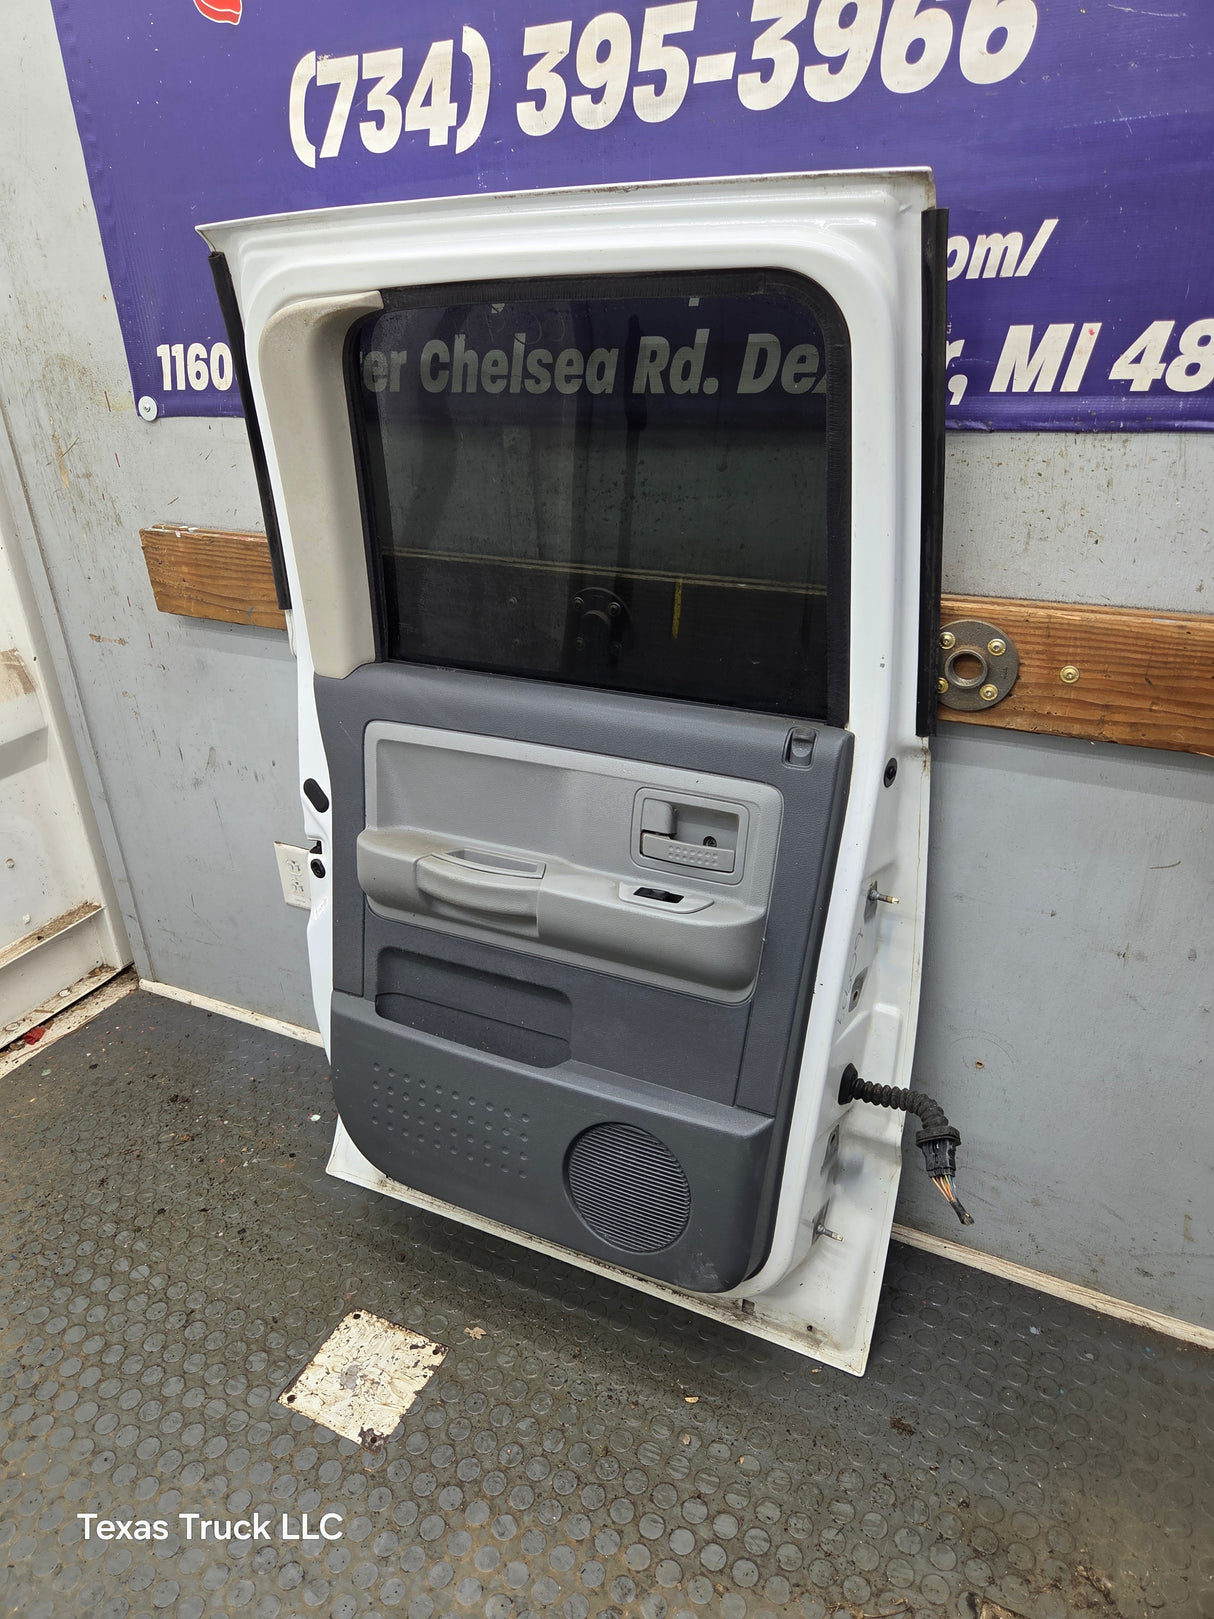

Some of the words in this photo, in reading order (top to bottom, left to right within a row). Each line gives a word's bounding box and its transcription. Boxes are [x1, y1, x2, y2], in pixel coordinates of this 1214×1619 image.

[289, 25, 491, 168] (734)
[516, 0, 1038, 137] 395-3966
[156, 342, 234, 391] 1160
[360, 350, 407, 393] er
[420, 332, 620, 394] Chelsea
[632, 328, 720, 394] Rd.
[736, 332, 827, 394] De
[988, 322, 1103, 392] MI
